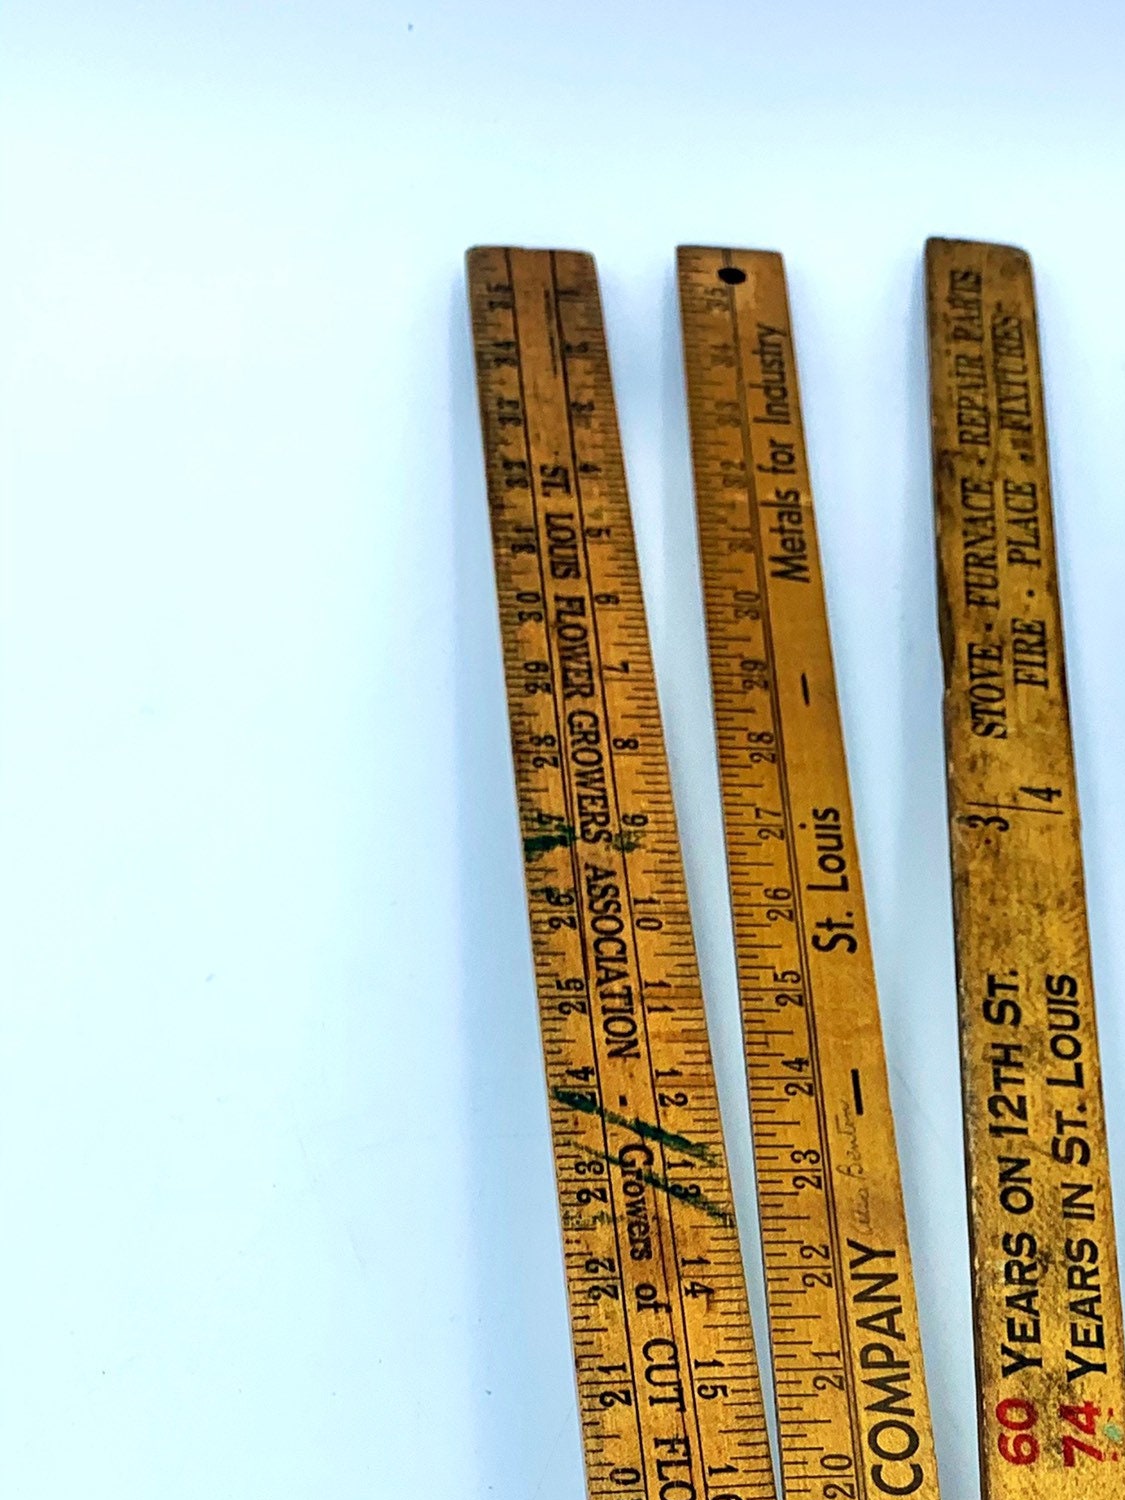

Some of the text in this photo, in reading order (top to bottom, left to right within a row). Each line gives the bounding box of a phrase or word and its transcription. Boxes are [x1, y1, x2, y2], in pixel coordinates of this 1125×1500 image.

[748, 322, 810, 583] Metals for Industry
[956, 354, 990, 446] REPAIR
[961, 478, 999, 610] FURNACE
[1004, 479, 1041, 569] PLACE
[967, 643, 1008, 740] STOVE
[1011, 618, 1049, 690] FIRE
[540, 464, 641, 1059] ST. LOUIS FLOWER GROWERS ASSOCIATION
[1019, 786, 1062, 803] 4
[799, 806, 857, 954] St. Louis
[618, 1144, 653, 1262] Growers
[983, 969, 1042, 1466] 60 YEARS ON 12TH ST.
[1045, 973, 1107, 1467] 74 YEARS IN ST. LOUIS
[635, 1282, 672, 1314] of
[642, 1338, 686, 1411] CUT
[846, 1237, 924, 1496] COMPANY
